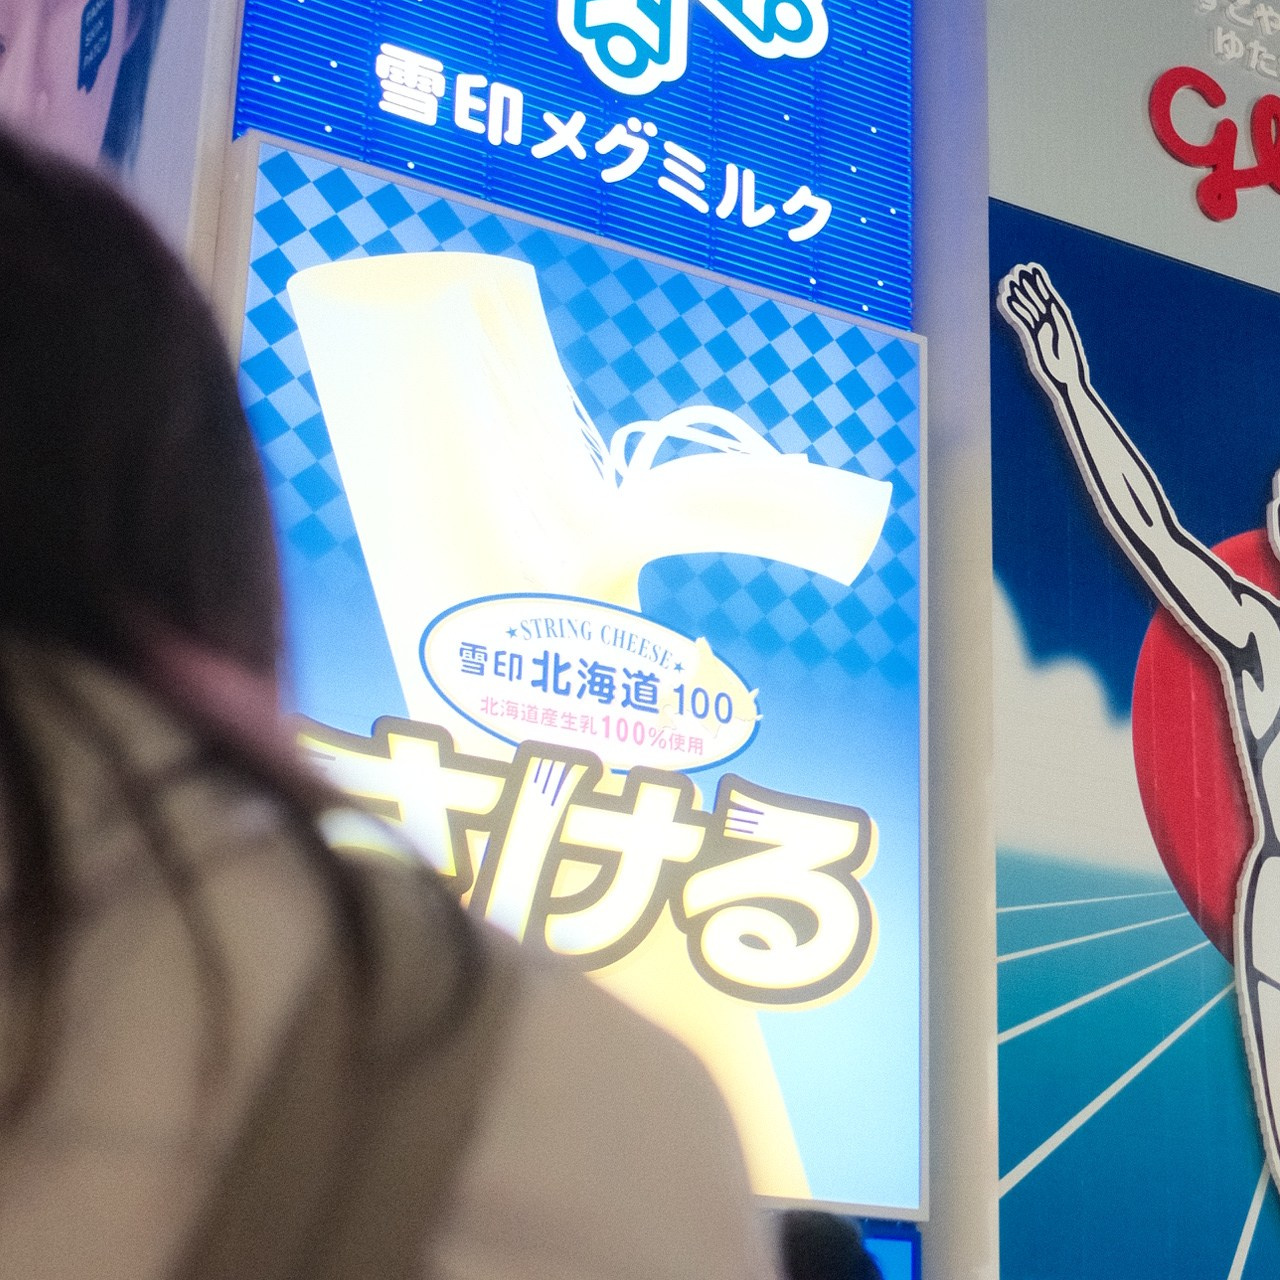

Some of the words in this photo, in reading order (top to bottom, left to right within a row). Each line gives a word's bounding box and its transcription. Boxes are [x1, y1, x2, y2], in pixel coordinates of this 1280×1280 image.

[374, 41, 834, 243] 雪印メグミルク
[520, 617, 592, 641] STRING
[600, 623, 674, 670] CHEESE
[480, 695, 705, 756] 北海道産生乳100%使用
